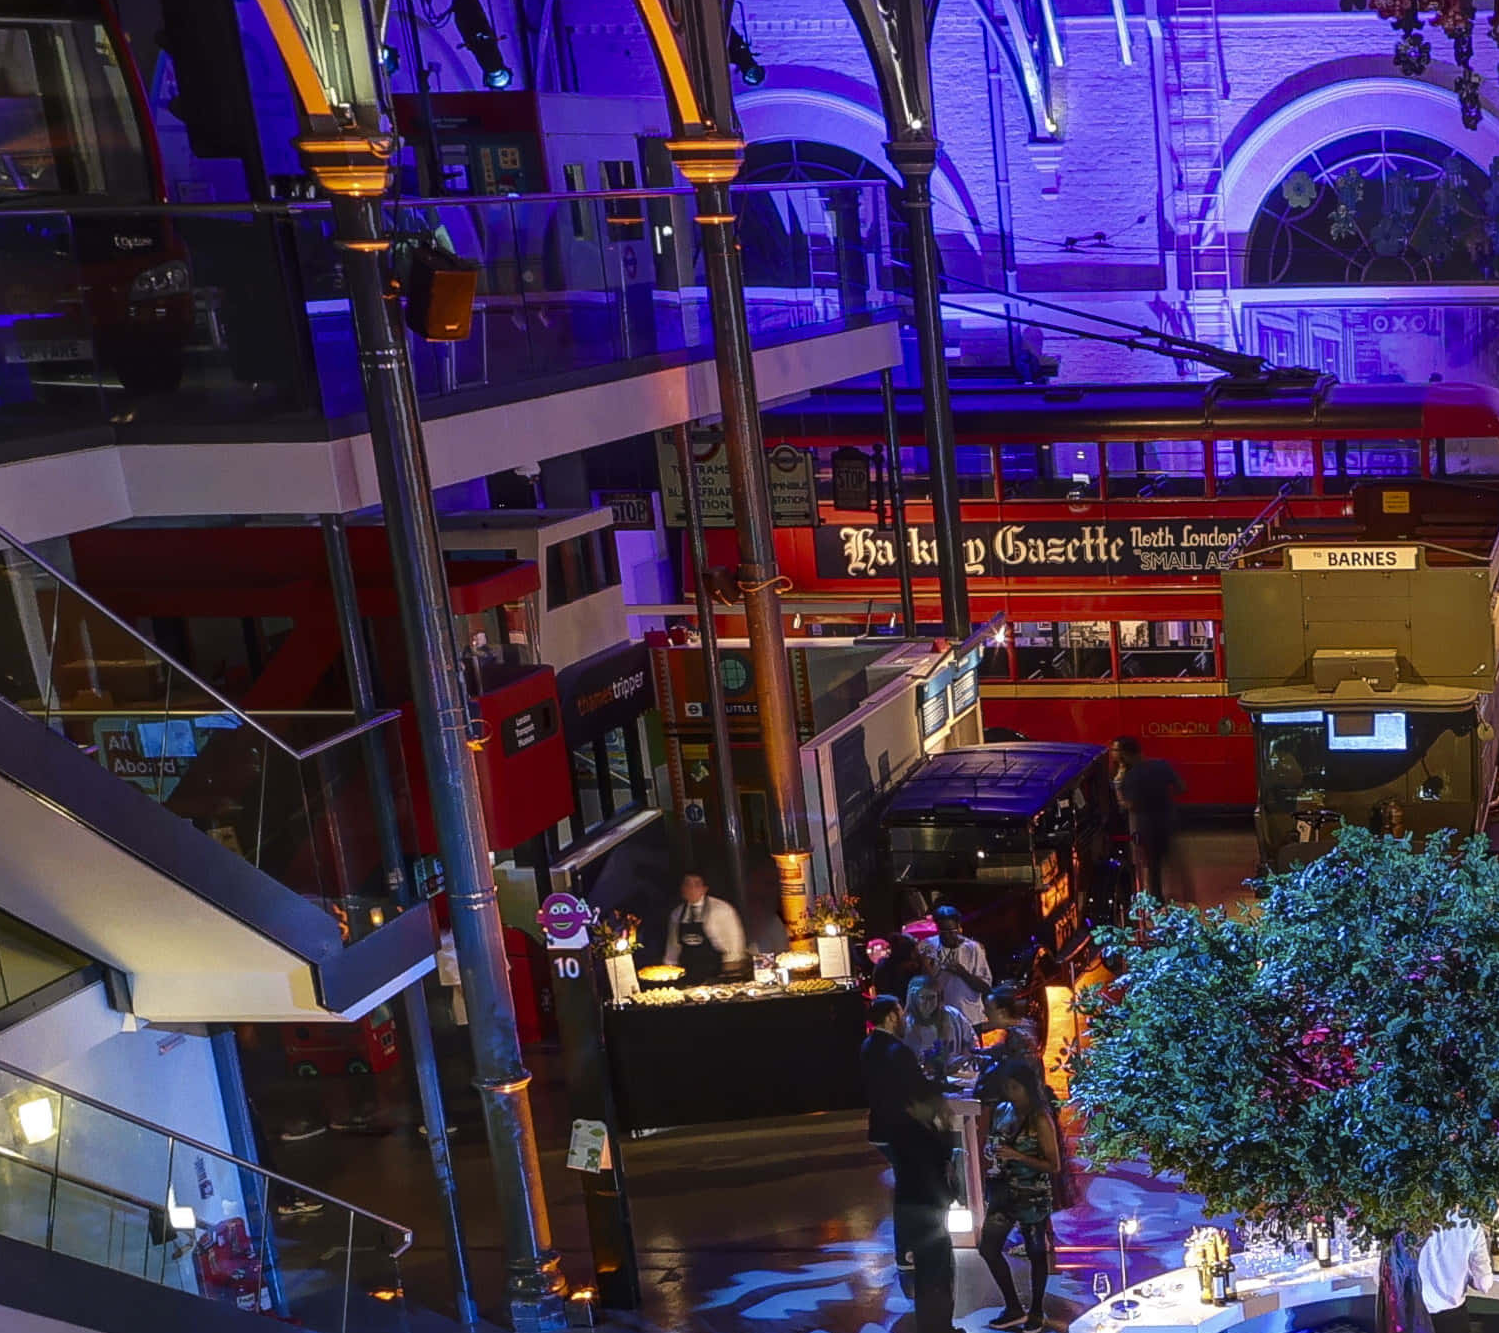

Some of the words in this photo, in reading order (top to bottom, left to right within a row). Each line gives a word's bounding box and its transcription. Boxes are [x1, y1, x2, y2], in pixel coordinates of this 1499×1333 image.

[1372, 314, 1427, 333] OXO
[994, 524, 1125, 566] Gazette
[1130, 525, 1176, 549] North
[1328, 551, 1397, 567] BARNES
[553, 956, 580, 979] 10
